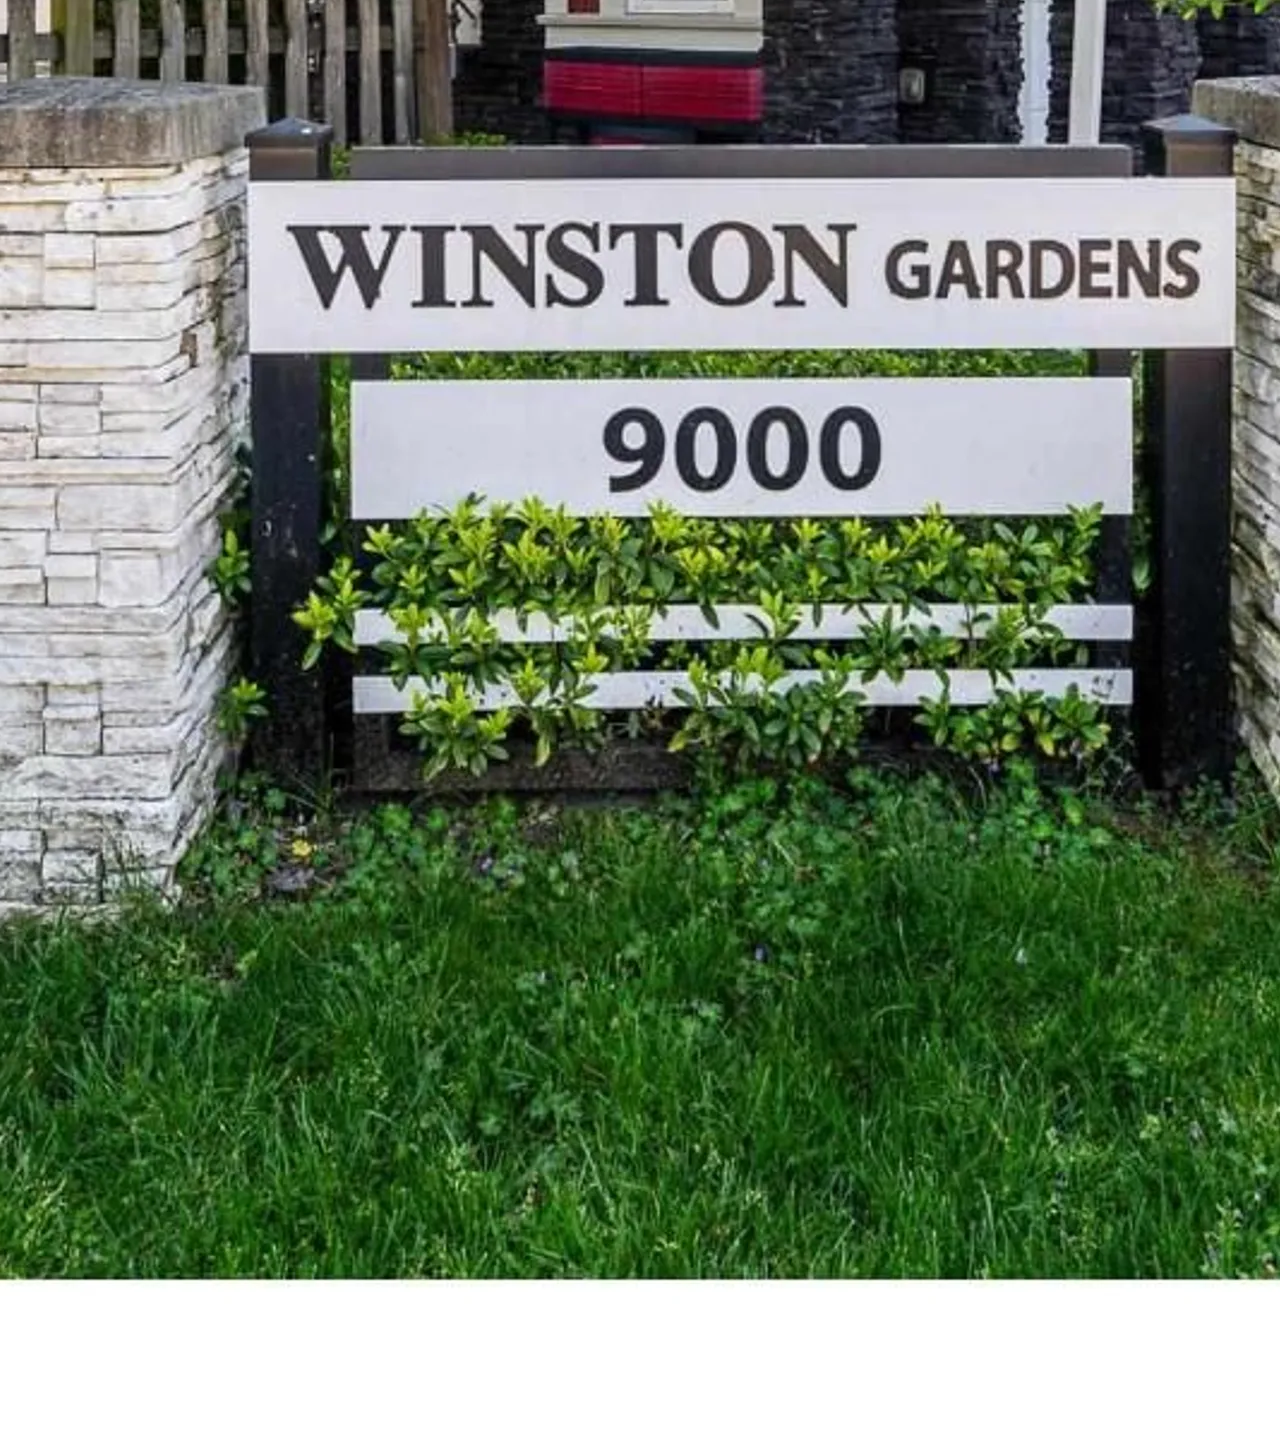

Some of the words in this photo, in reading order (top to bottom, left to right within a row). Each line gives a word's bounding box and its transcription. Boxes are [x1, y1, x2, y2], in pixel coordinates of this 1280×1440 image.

[286, 221, 858, 310] WINSTON
[884, 239, 1202, 300] GARDENS
[602, 405, 882, 493] 9000
